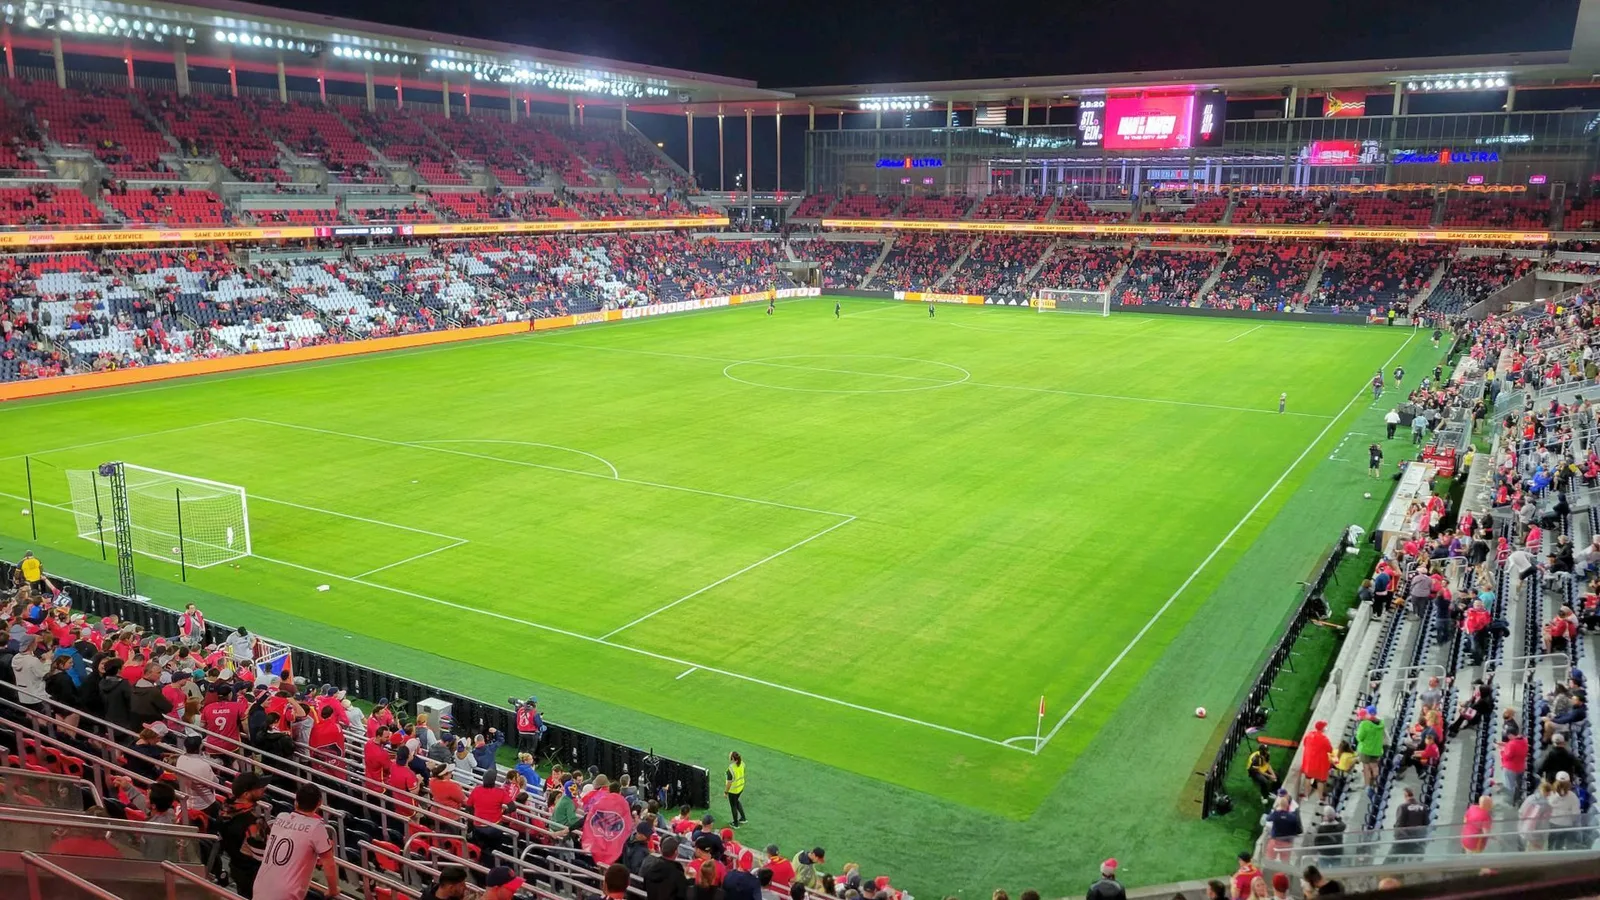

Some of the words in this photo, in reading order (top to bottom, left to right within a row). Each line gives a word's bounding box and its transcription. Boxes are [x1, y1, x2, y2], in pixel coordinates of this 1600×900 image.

[1451, 151, 1499, 163] ULTRA
[114, 232, 143, 240] SERVICE
[215, 717, 227, 731] 9
[264, 834, 294, 866] 10
